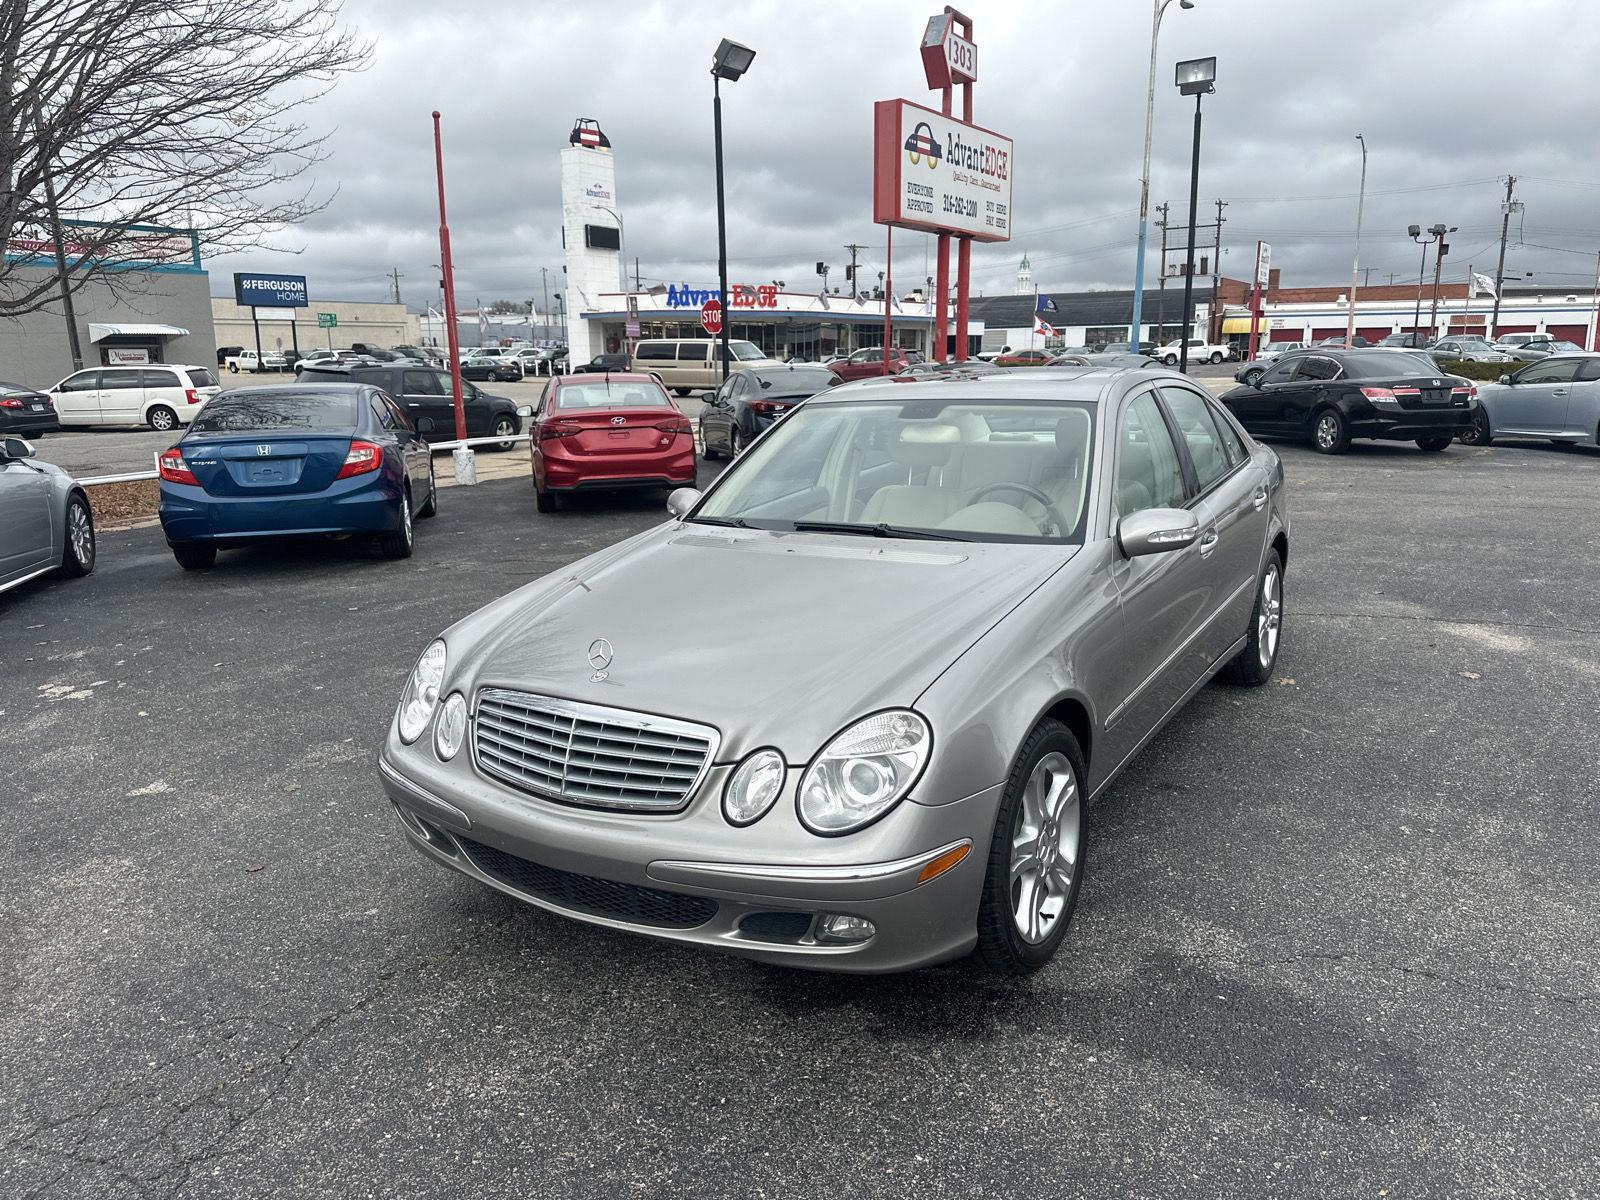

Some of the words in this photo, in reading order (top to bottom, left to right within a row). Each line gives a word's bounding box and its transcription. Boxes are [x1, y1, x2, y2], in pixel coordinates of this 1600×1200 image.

[948, 37, 972, 71] 1303
[946, 132, 1008, 180] AdvantEDGE
[907, 182, 934, 198] EVERYONE
[906, 198, 934, 214] APPROVED
[943, 193, 978, 218] 316-262-1200
[251, 280, 304, 291] FERGUSON
[277, 291, 305, 301] HOME
